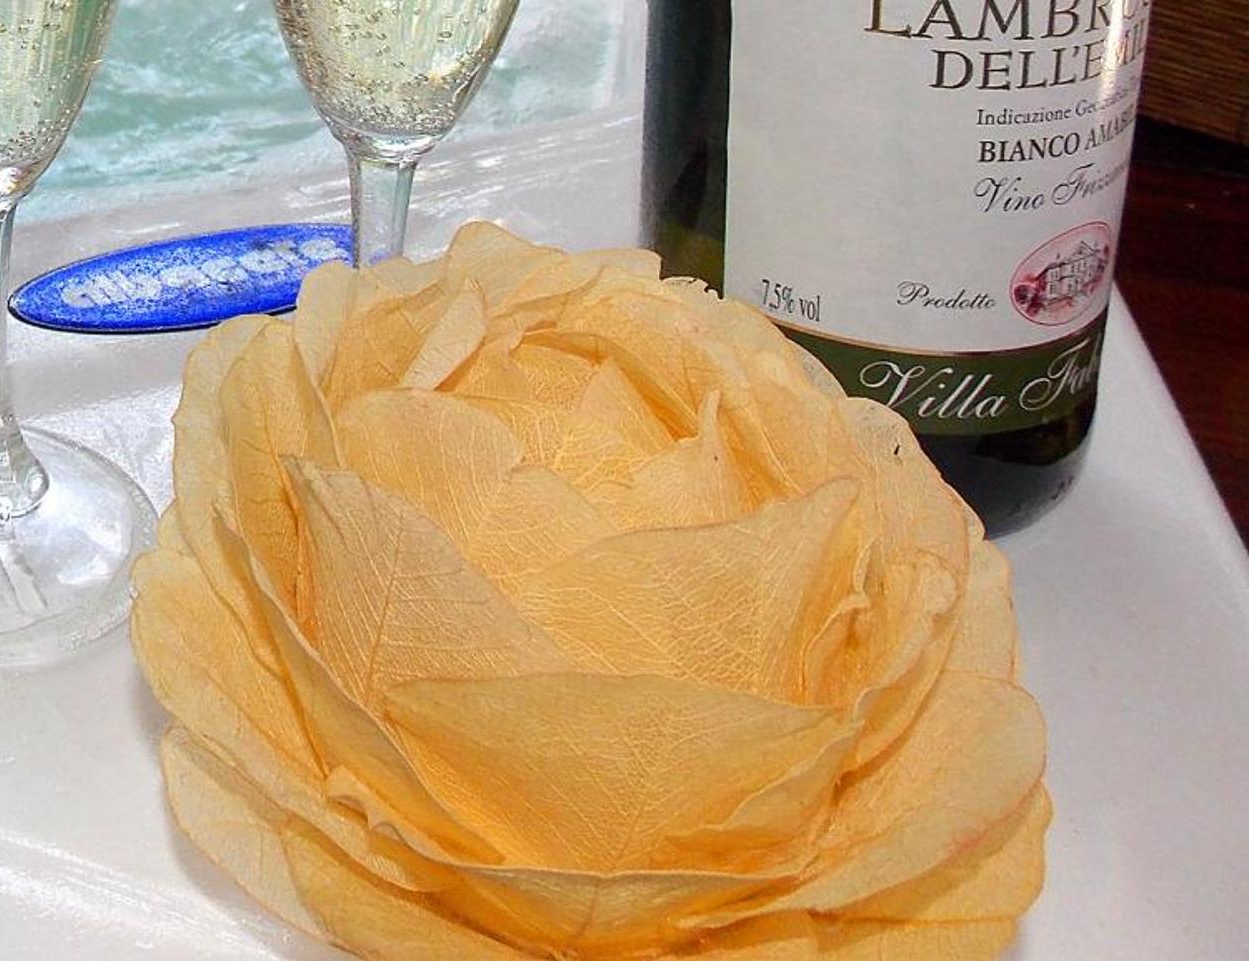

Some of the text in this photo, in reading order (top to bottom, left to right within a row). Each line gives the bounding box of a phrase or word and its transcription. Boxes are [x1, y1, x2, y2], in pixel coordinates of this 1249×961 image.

[976, 107, 1071, 126] Indicazione
[978, 132, 1080, 162] BIANCO
[973, 176, 1045, 213] Vino
[799, 294, 820, 322] vol
[896, 280, 997, 310] Prodotto
[859, 360, 1008, 420] Villa
